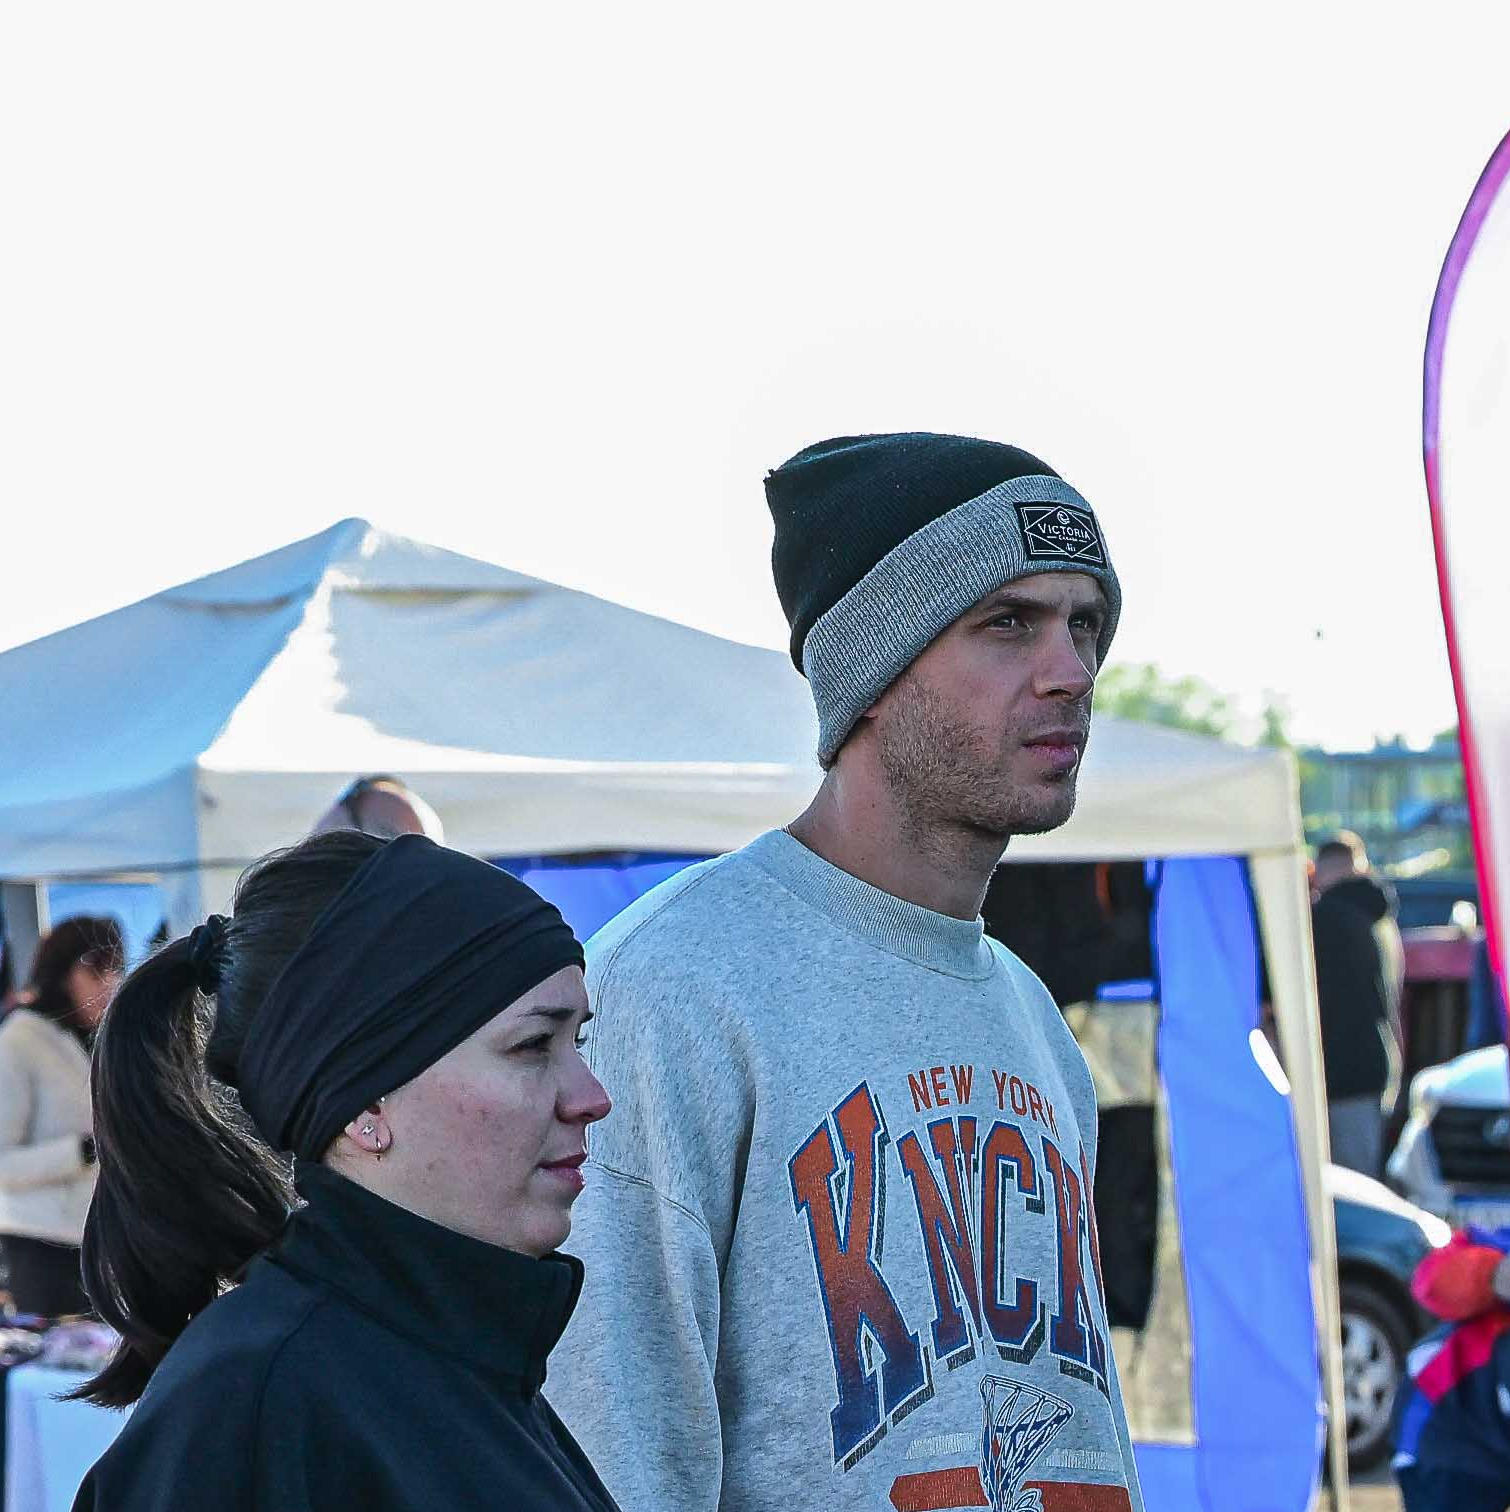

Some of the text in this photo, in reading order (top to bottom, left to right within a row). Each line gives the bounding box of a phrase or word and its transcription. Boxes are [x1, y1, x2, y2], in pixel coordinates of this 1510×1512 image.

[1037, 523, 1091, 540] VICTORIA
[907, 1064, 1061, 1142] NEW YORK
